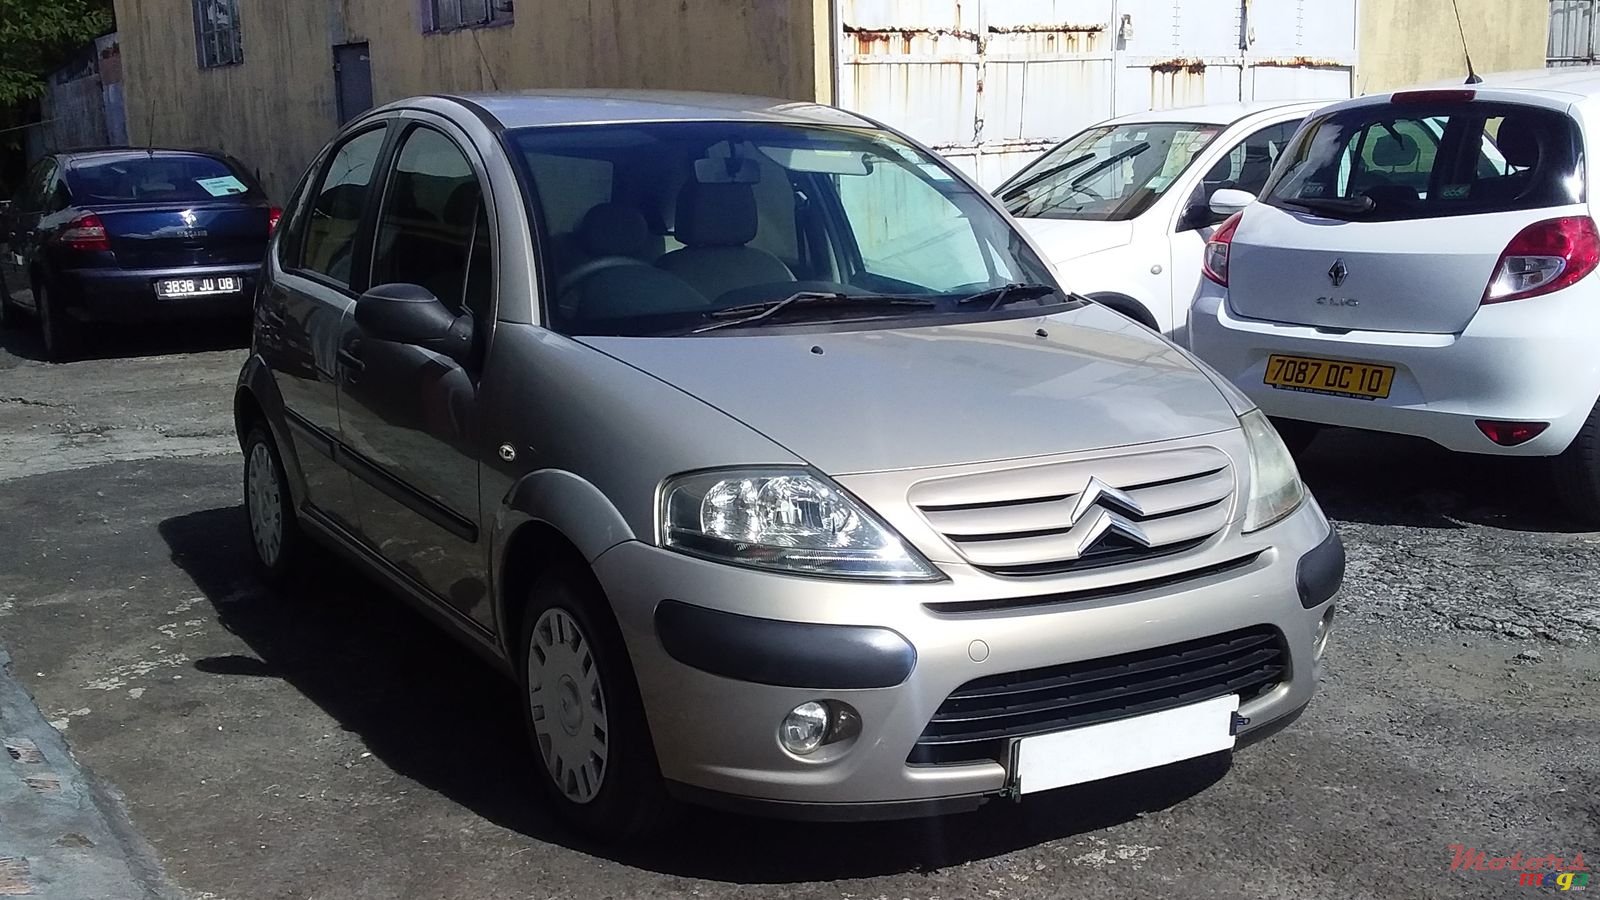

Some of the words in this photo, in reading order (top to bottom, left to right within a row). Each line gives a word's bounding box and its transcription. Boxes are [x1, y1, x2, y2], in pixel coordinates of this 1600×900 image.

[200, 279, 214, 291] JU
[218, 278, 233, 290] 08
[1316, 296, 1359, 307] CLIO
[1273, 359, 1322, 385] 7087
[1325, 364, 1353, 389] DC
[1358, 367, 1383, 393] 10
